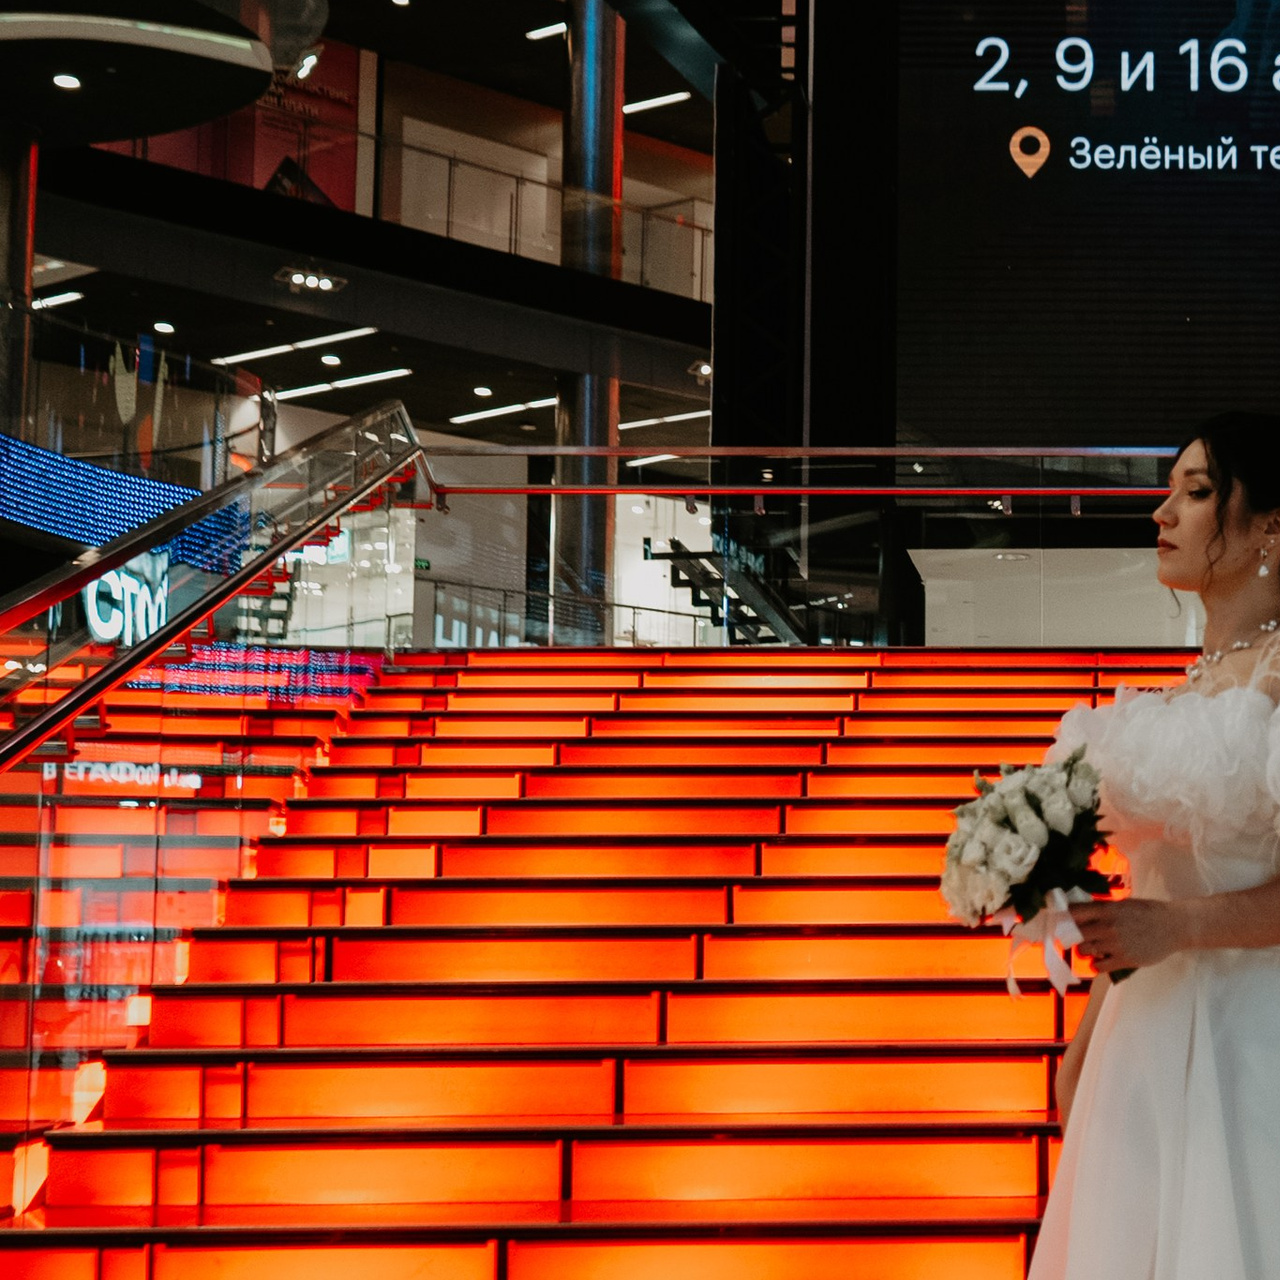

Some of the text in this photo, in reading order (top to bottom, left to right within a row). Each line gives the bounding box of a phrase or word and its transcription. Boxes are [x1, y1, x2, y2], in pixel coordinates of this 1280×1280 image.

[972, 37, 1031, 101] 2,
[1053, 37, 1096, 94] 9
[1119, 51, 1156, 93] и
[1177, 37, 1249, 94] 16
[1068, 137, 1239, 172] Зелёный
